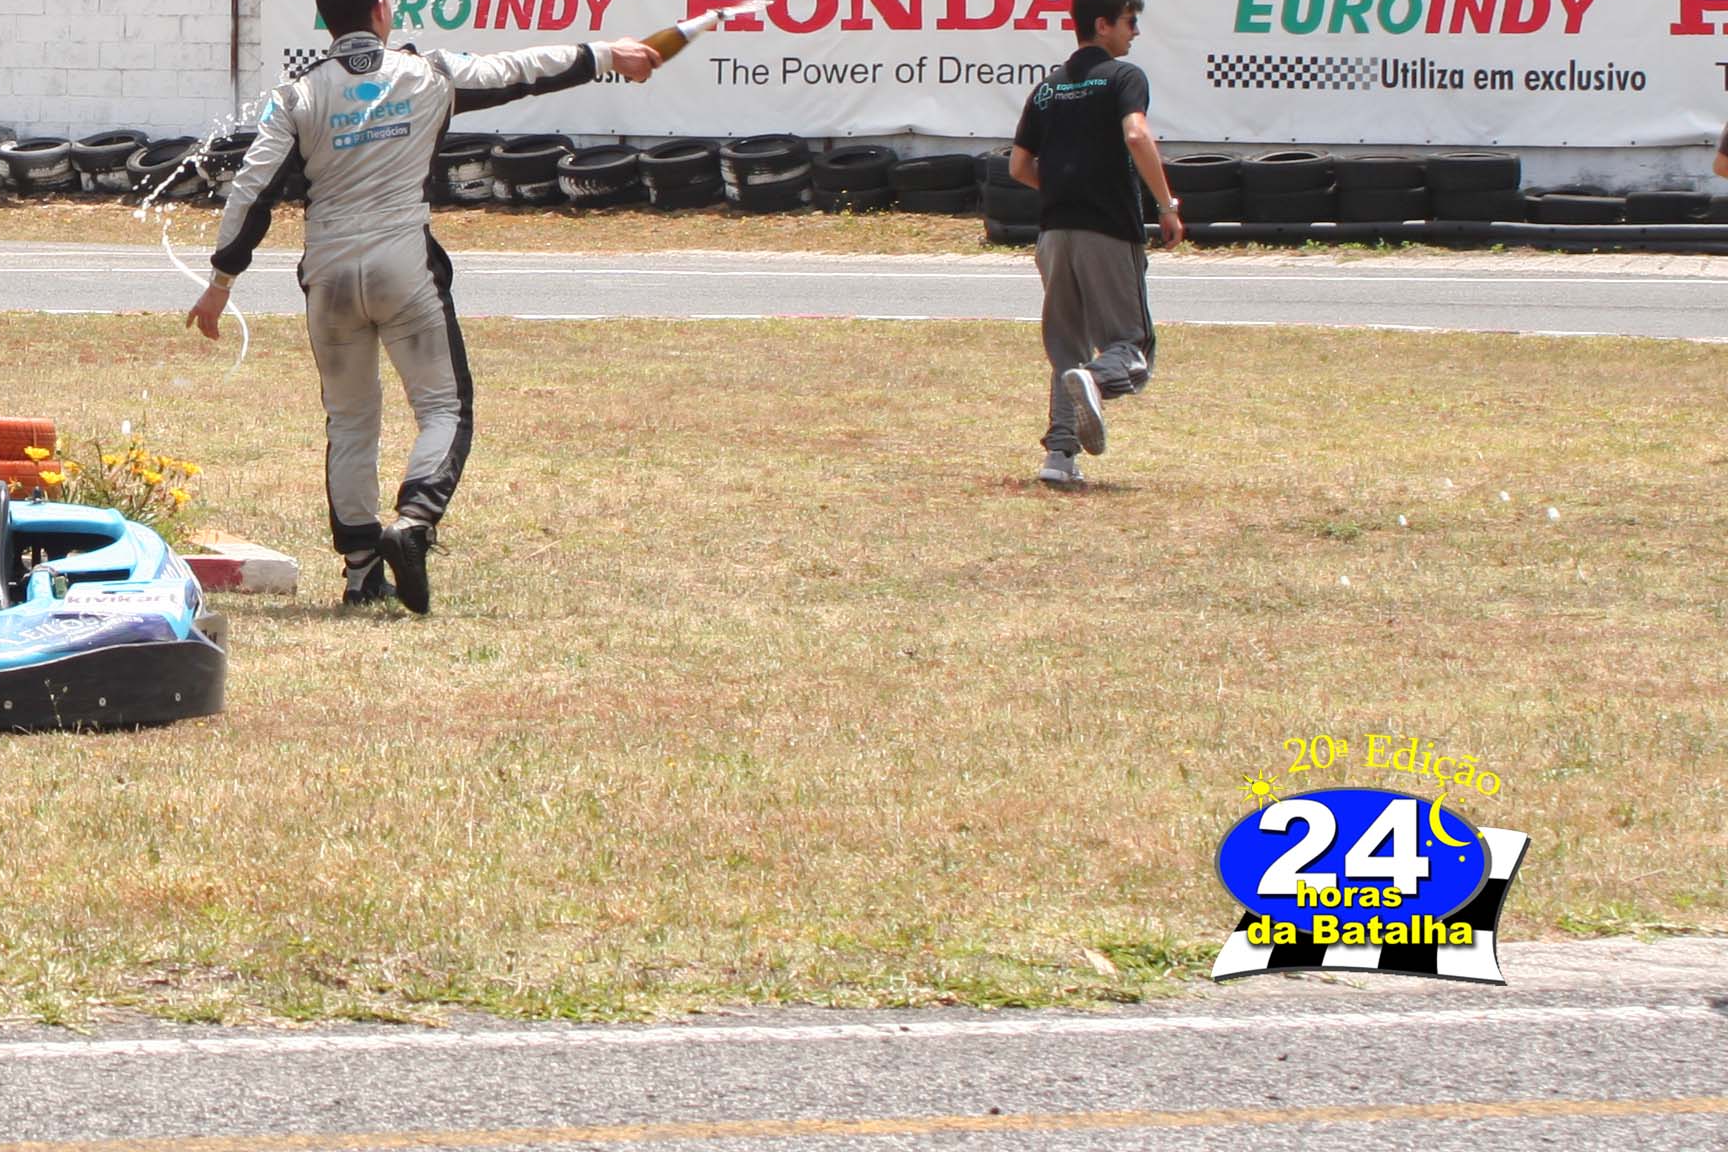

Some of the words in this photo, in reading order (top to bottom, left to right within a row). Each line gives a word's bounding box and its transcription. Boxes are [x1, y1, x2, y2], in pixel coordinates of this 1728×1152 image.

[710, 57, 770, 85] The
[782, 56, 882, 85] Power
[895, 55, 929, 85] of
[1380, 58, 1465, 91] Utiliza
[1474, 67, 1514, 92] em
[1525, 59, 1647, 92] exclusivo
